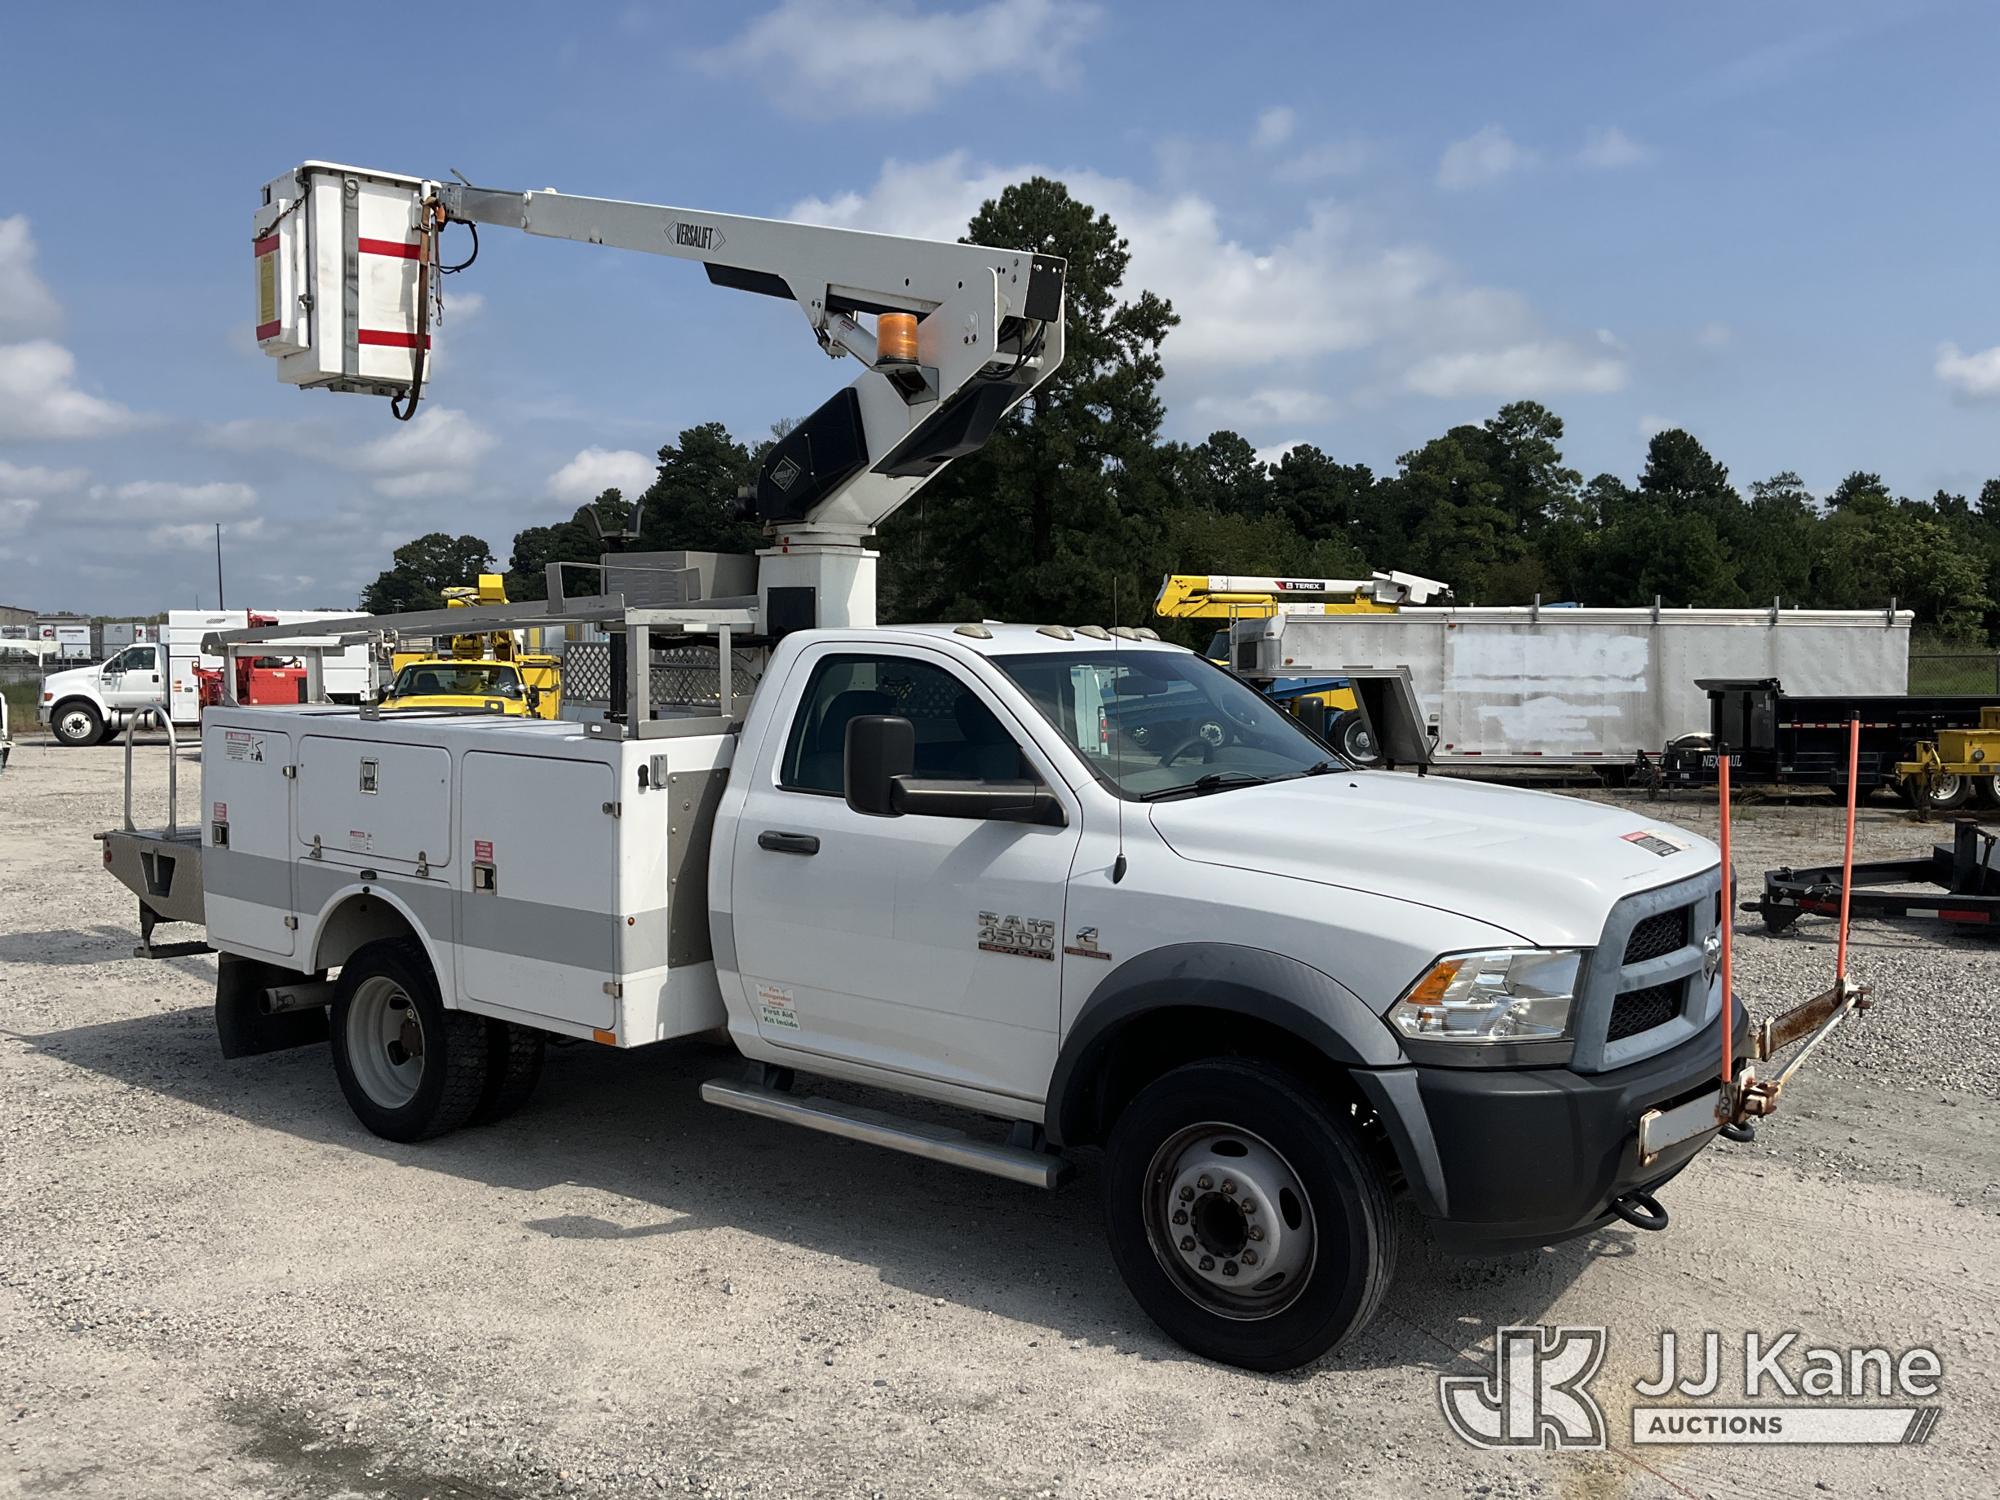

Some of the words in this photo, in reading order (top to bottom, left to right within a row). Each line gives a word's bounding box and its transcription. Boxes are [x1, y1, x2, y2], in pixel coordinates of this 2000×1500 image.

[676, 223, 713, 249] VERSALIFT
[1702, 755, 1742, 769] NEXUL
[979, 911, 1055, 936] RAM
[978, 926, 1055, 951] 4500
[763, 1007, 780, 1016] First
[782, 1010, 794, 1019] Aid
[764, 1016, 775, 1024] Kit
[776, 1018, 799, 1028] Inside
